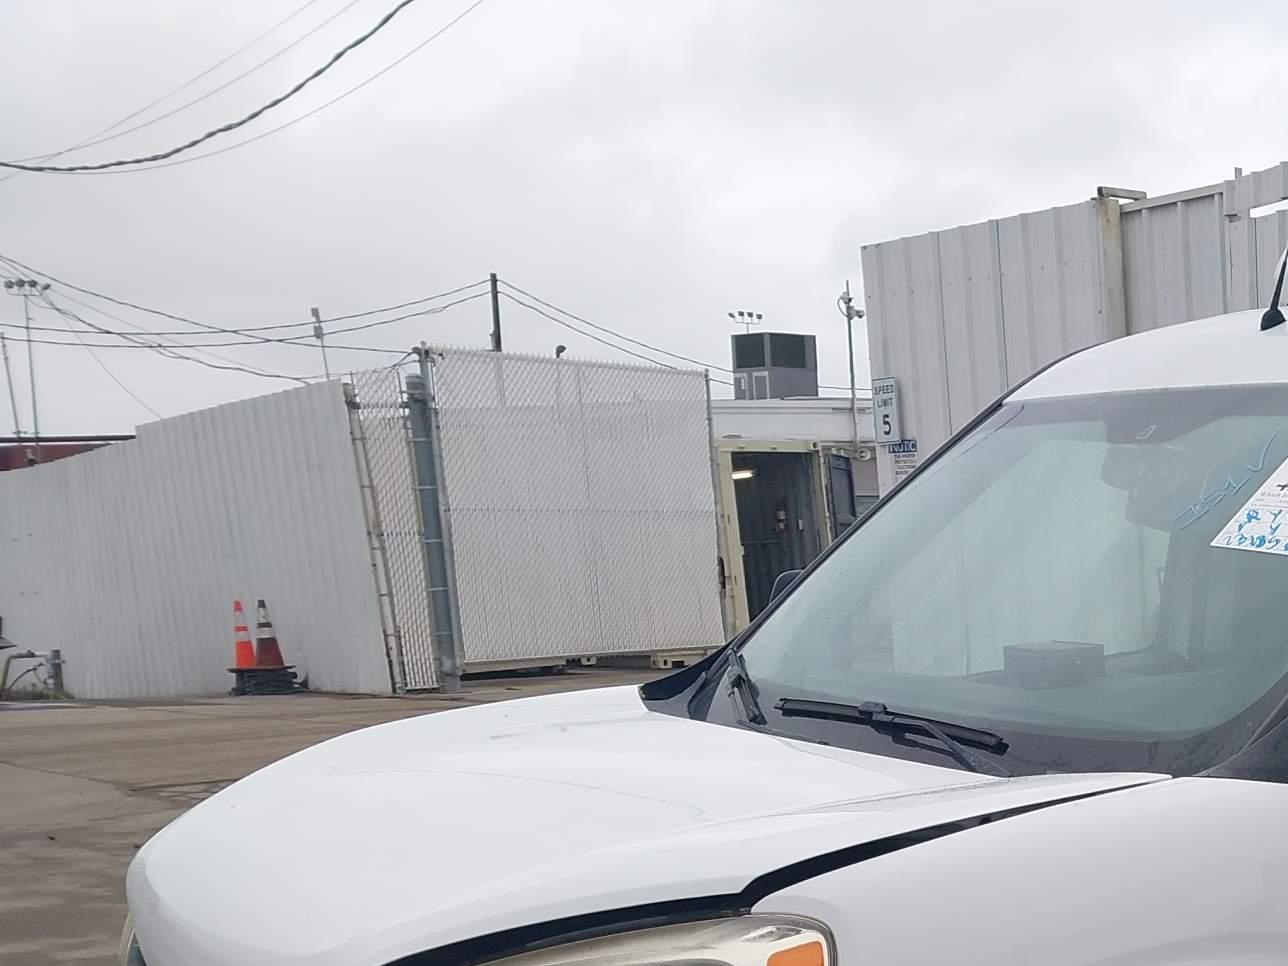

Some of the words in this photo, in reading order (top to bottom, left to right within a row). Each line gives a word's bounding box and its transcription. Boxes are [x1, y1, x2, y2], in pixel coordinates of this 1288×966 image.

[874, 384, 894, 395] SPEED
[877, 397, 893, 408] LIMIT
[882, 414, 892, 436] 5
